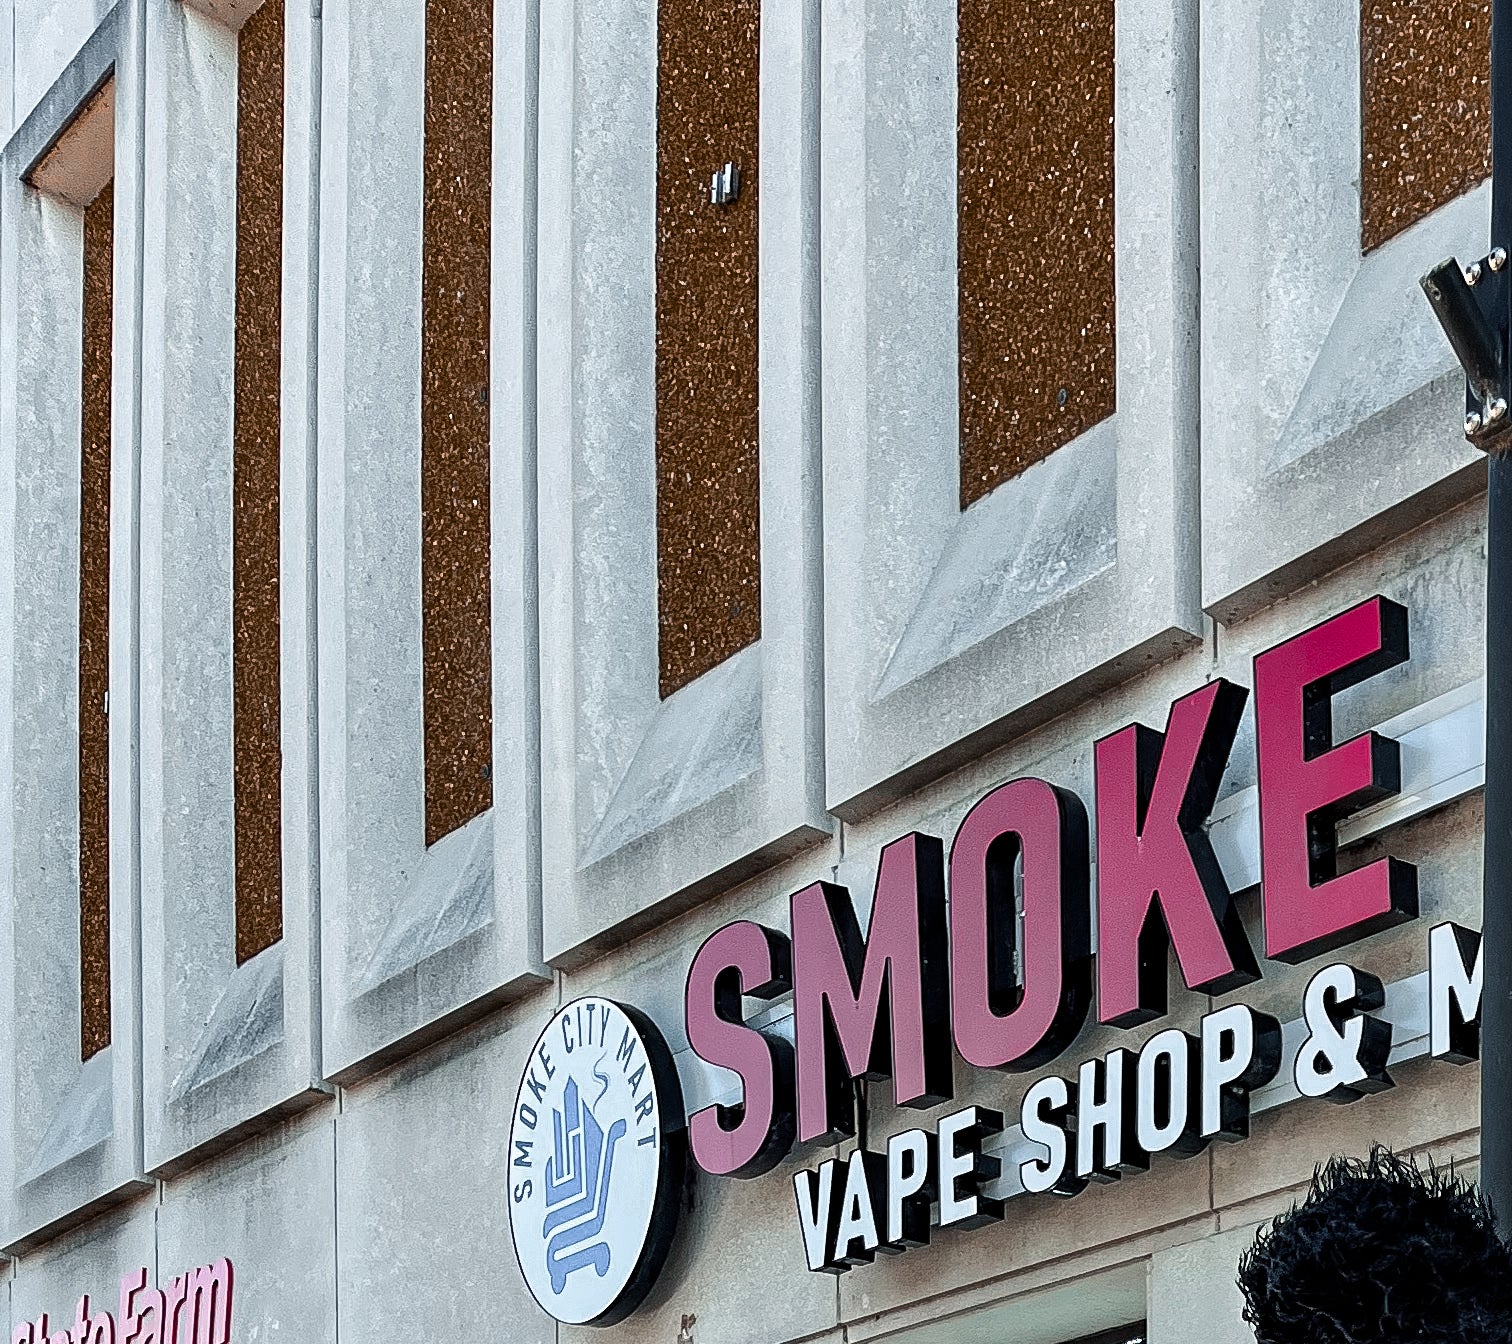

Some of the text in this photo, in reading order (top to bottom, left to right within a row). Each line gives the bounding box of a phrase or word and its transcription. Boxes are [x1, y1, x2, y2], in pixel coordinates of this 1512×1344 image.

[686, 594, 1400, 1178] SMOKE
[514, 1003, 657, 1204] SMOKE CITY MART
[794, 1106, 984, 1271] VAPE
[1020, 1003, 1257, 1194] SHOP
[1294, 962, 1370, 1098] &
